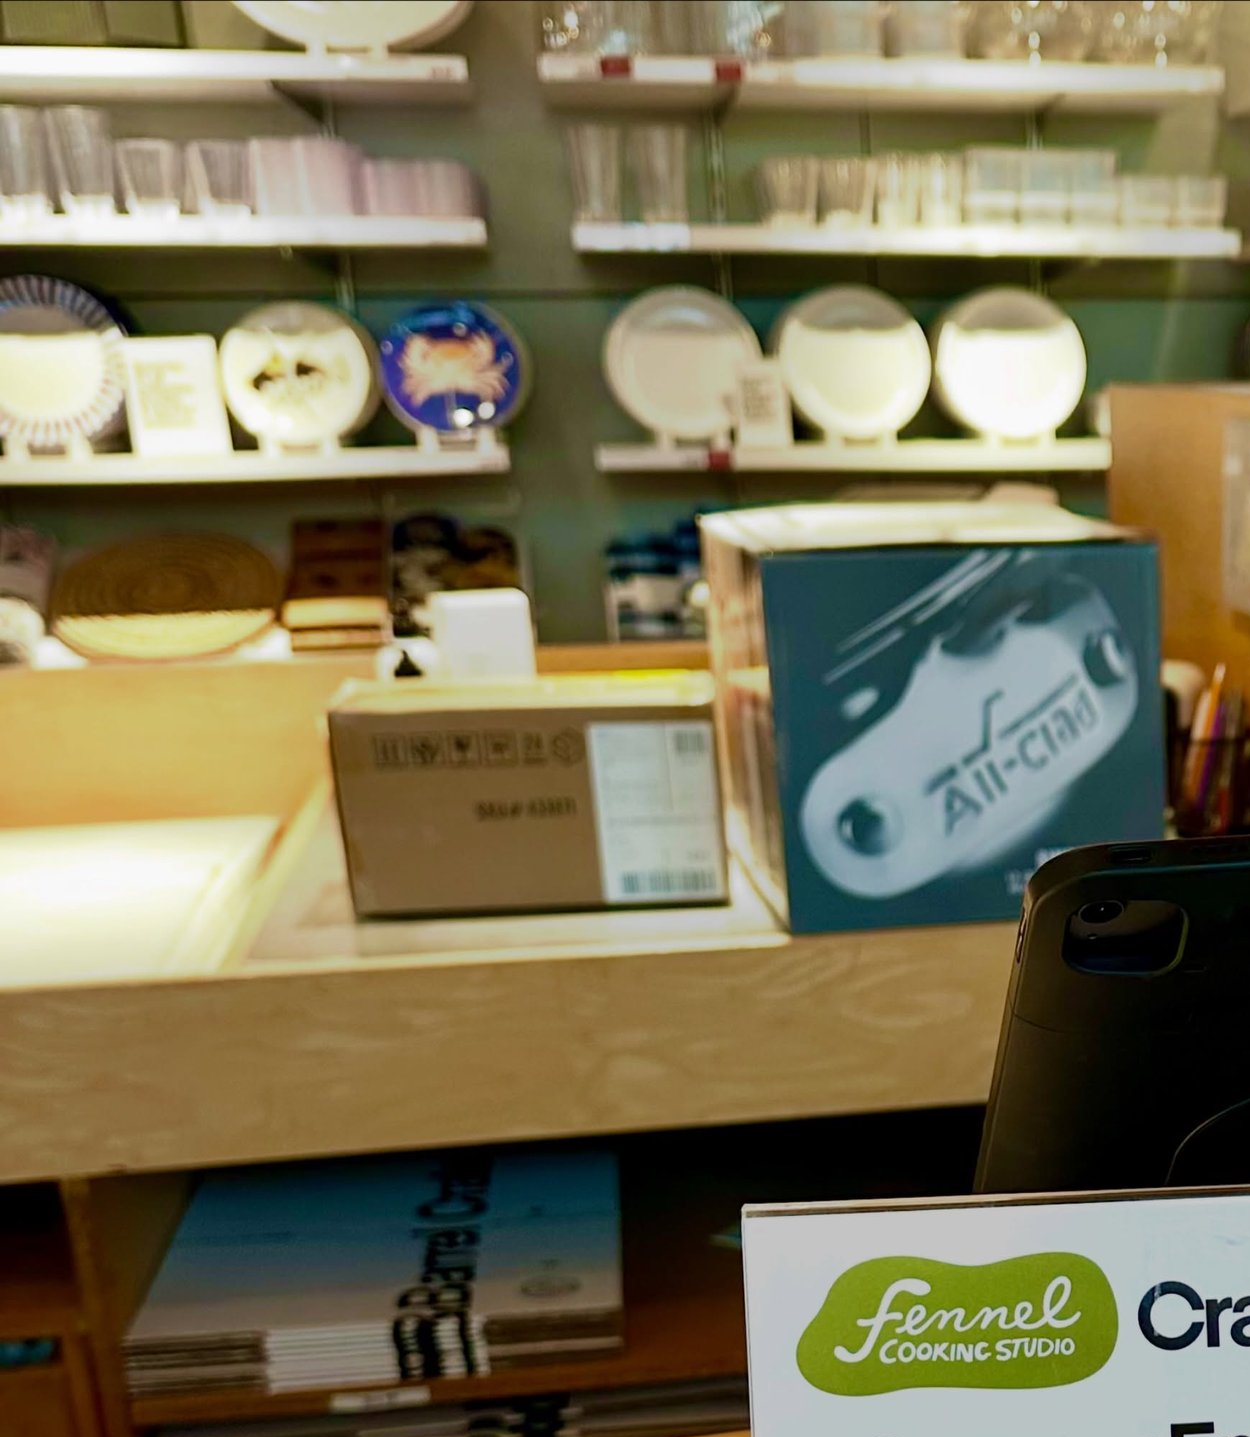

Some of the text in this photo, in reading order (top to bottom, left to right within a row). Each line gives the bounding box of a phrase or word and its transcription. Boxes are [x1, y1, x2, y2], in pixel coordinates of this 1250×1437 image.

[945, 688, 1098, 838] All-Clad
[834, 1275, 1081, 1363] fennel
[879, 1338, 1076, 1364] COOKING STUDIO
